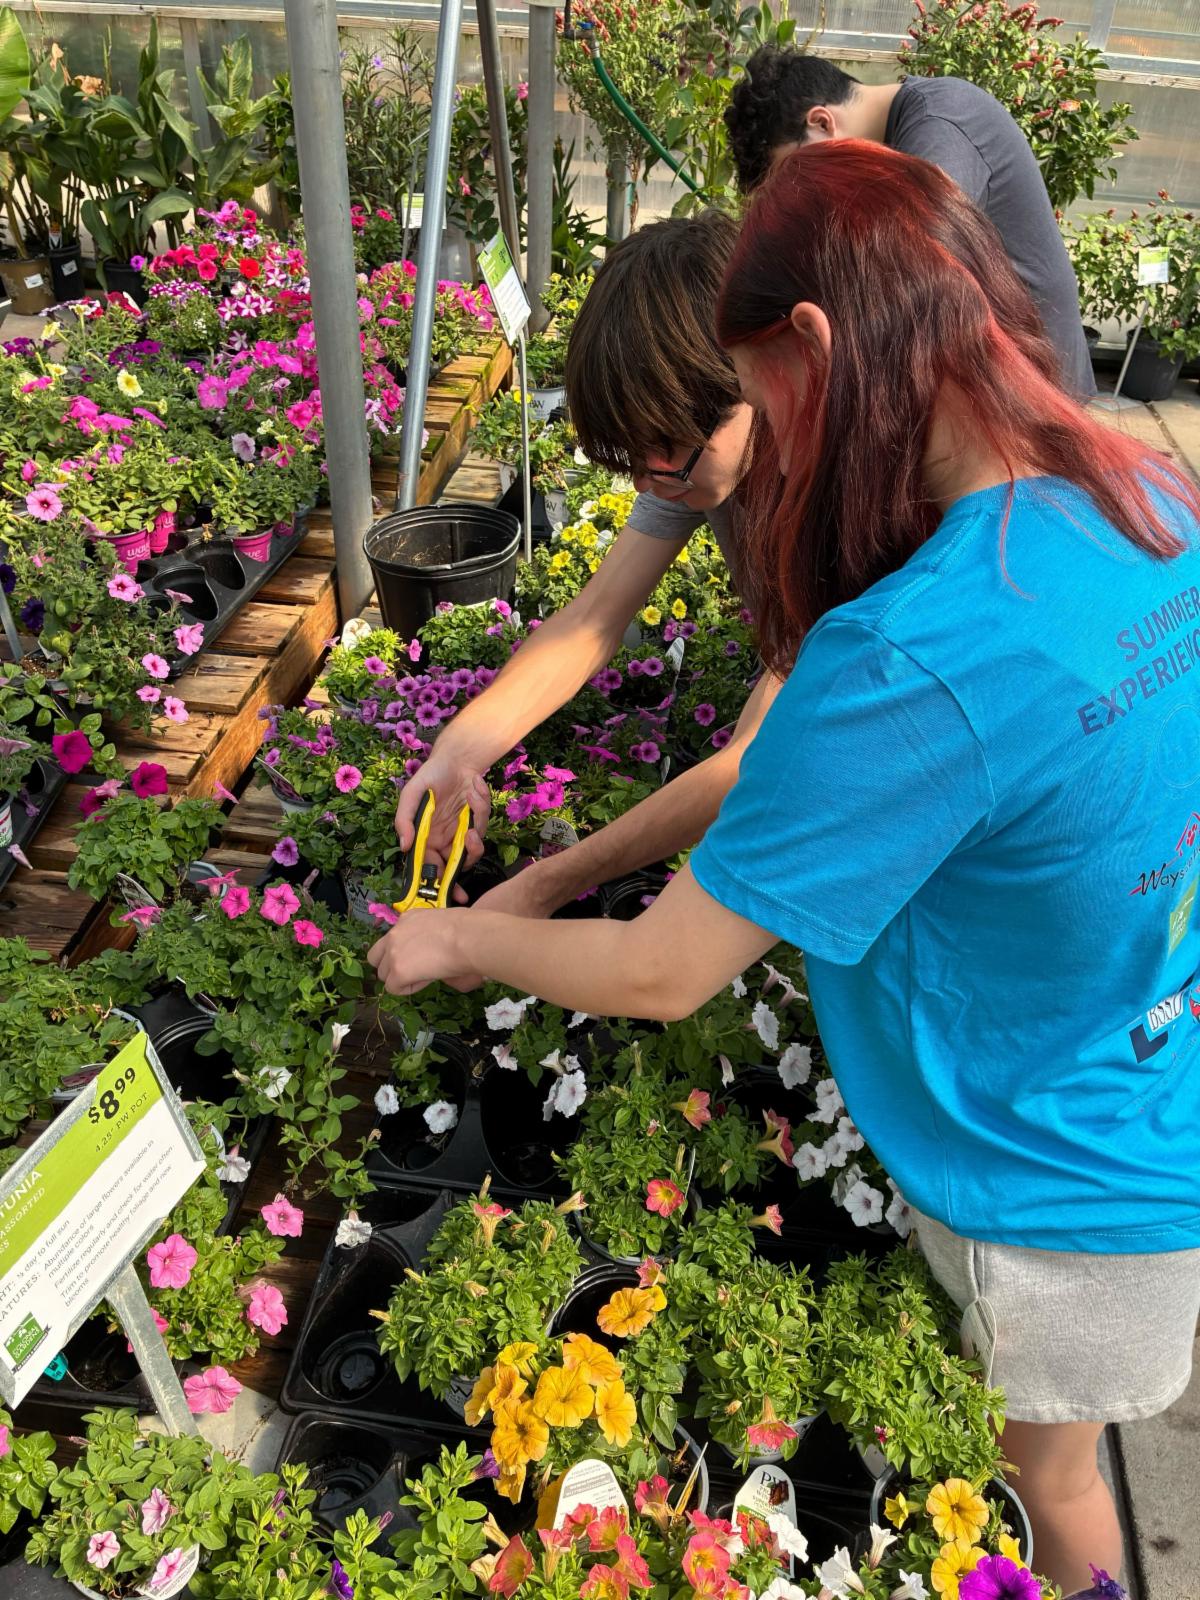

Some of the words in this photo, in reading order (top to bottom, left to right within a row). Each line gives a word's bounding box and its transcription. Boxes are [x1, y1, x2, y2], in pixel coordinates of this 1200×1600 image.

[1116, 586, 1200, 662] SUMMER
[116, 1112, 129, 1129] PW
[130, 1092, 148, 1113] POT
[0, 1272, 41, 1321] ATURES:
[44, 1228, 80, 1272] Abundance
[38, 1247, 46, 1257] to
[48, 1247, 76, 1279] multiple
[74, 1224, 94, 1248] colors
